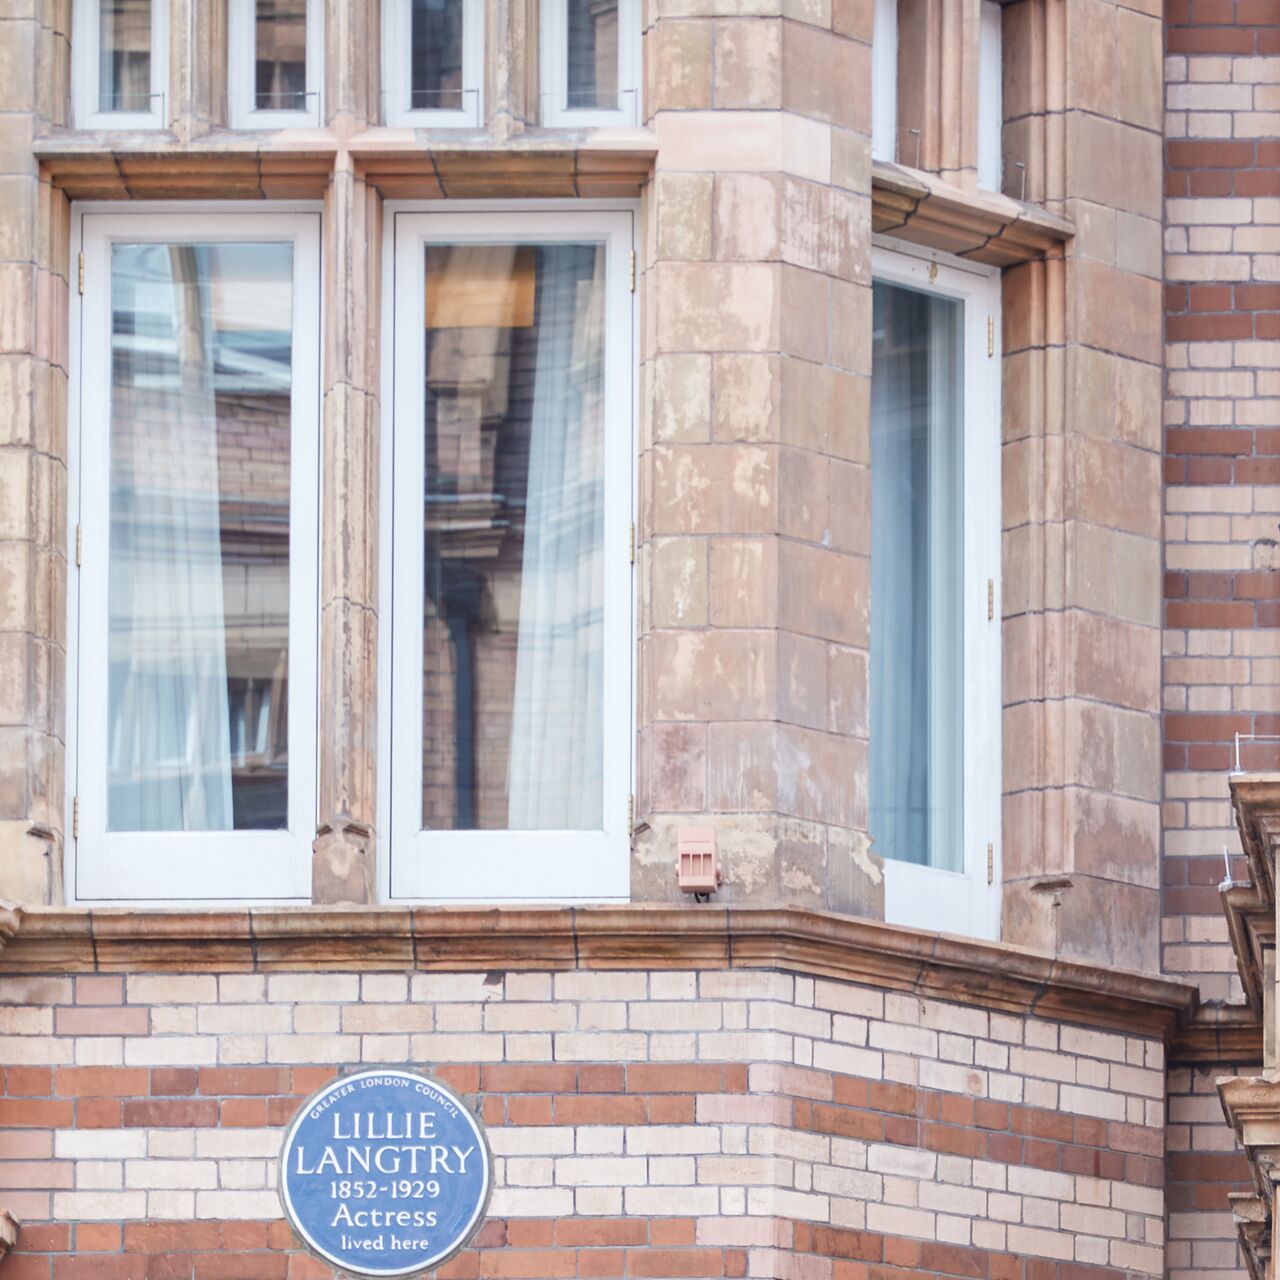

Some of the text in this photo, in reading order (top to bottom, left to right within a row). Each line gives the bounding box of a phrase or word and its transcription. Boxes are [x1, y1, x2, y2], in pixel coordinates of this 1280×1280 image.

[310, 1077, 460, 1120] GREATER LONDON COUNCIL
[333, 1112, 436, 1140] LILLIE
[296, 1146, 475, 1175] LANGTRY
[330, 1180, 440, 1199] 1852-1929
[330, 1203, 437, 1228] Actress
[341, 1234, 429, 1251] lived here
